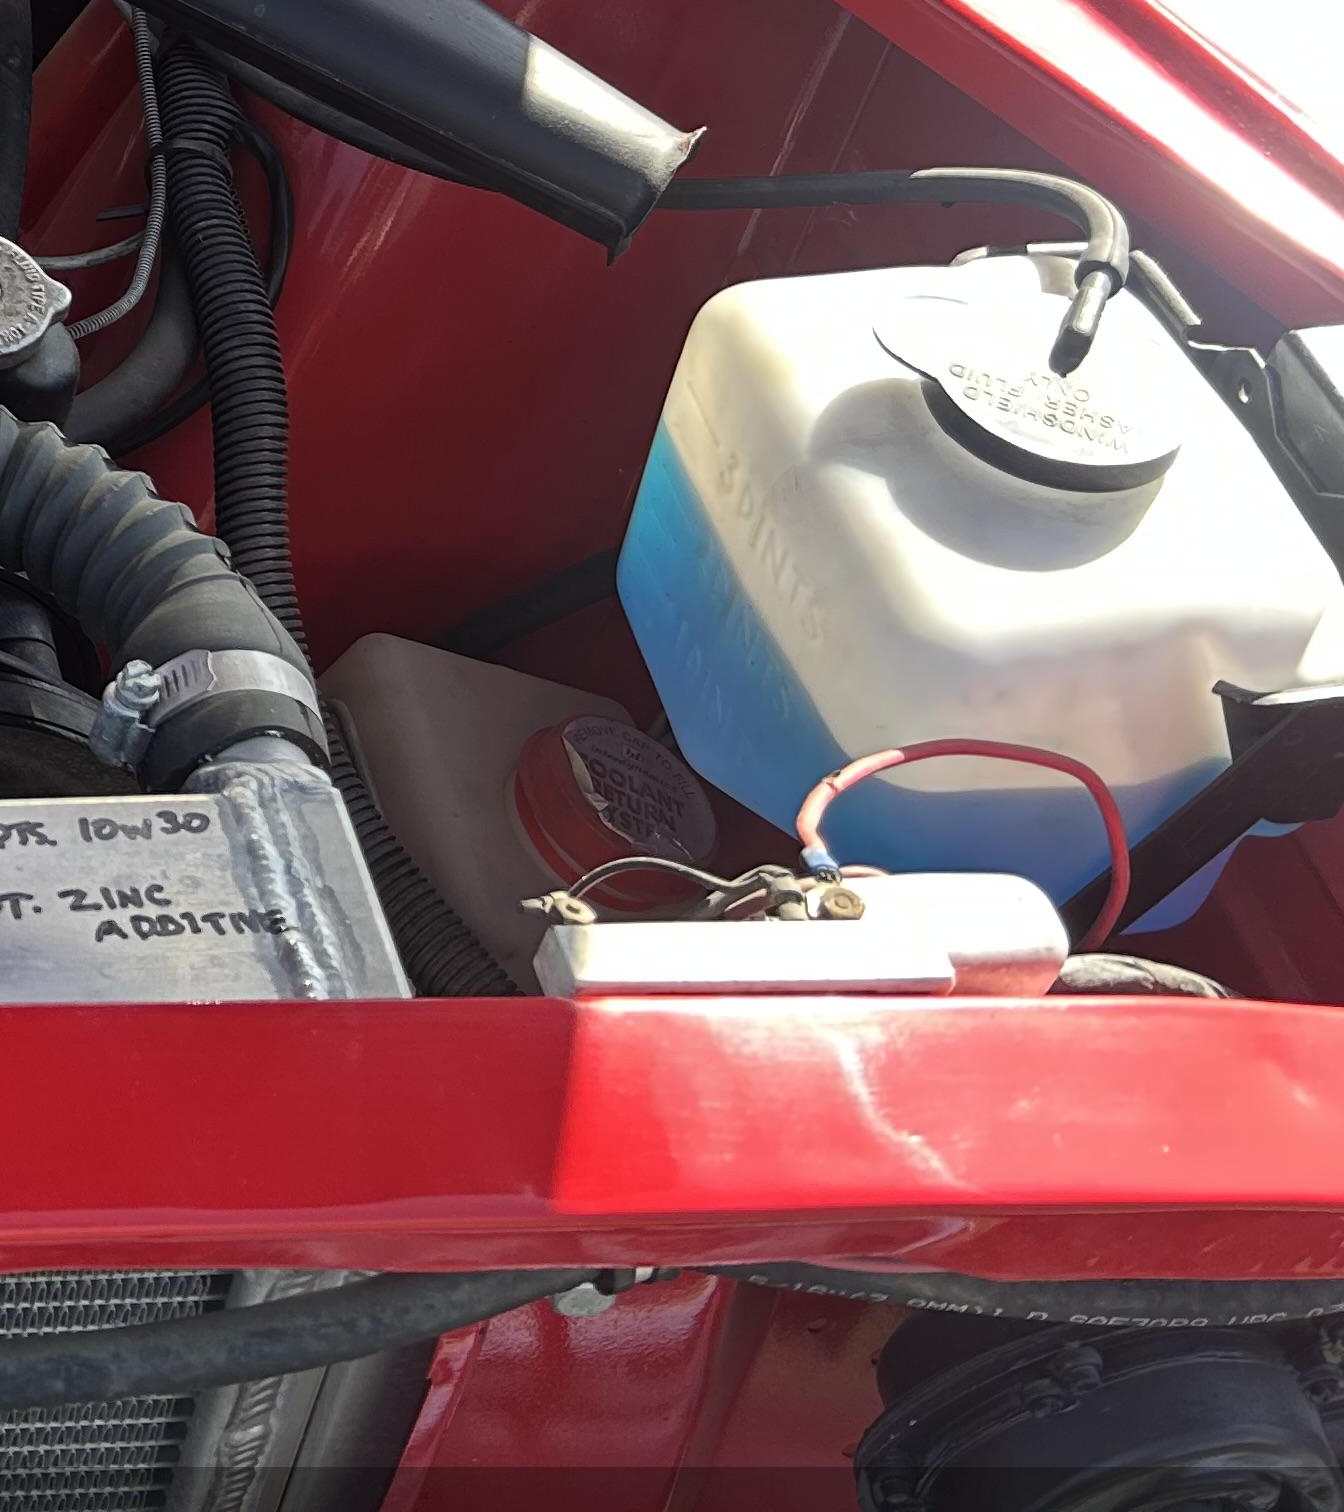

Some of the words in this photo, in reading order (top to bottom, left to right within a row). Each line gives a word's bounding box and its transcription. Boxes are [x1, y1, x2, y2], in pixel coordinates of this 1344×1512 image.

[1044, 394, 1133, 435] ASHER
[58, 884, 172, 910] ZINC
[95, 908, 289, 942] ADDITIVE
